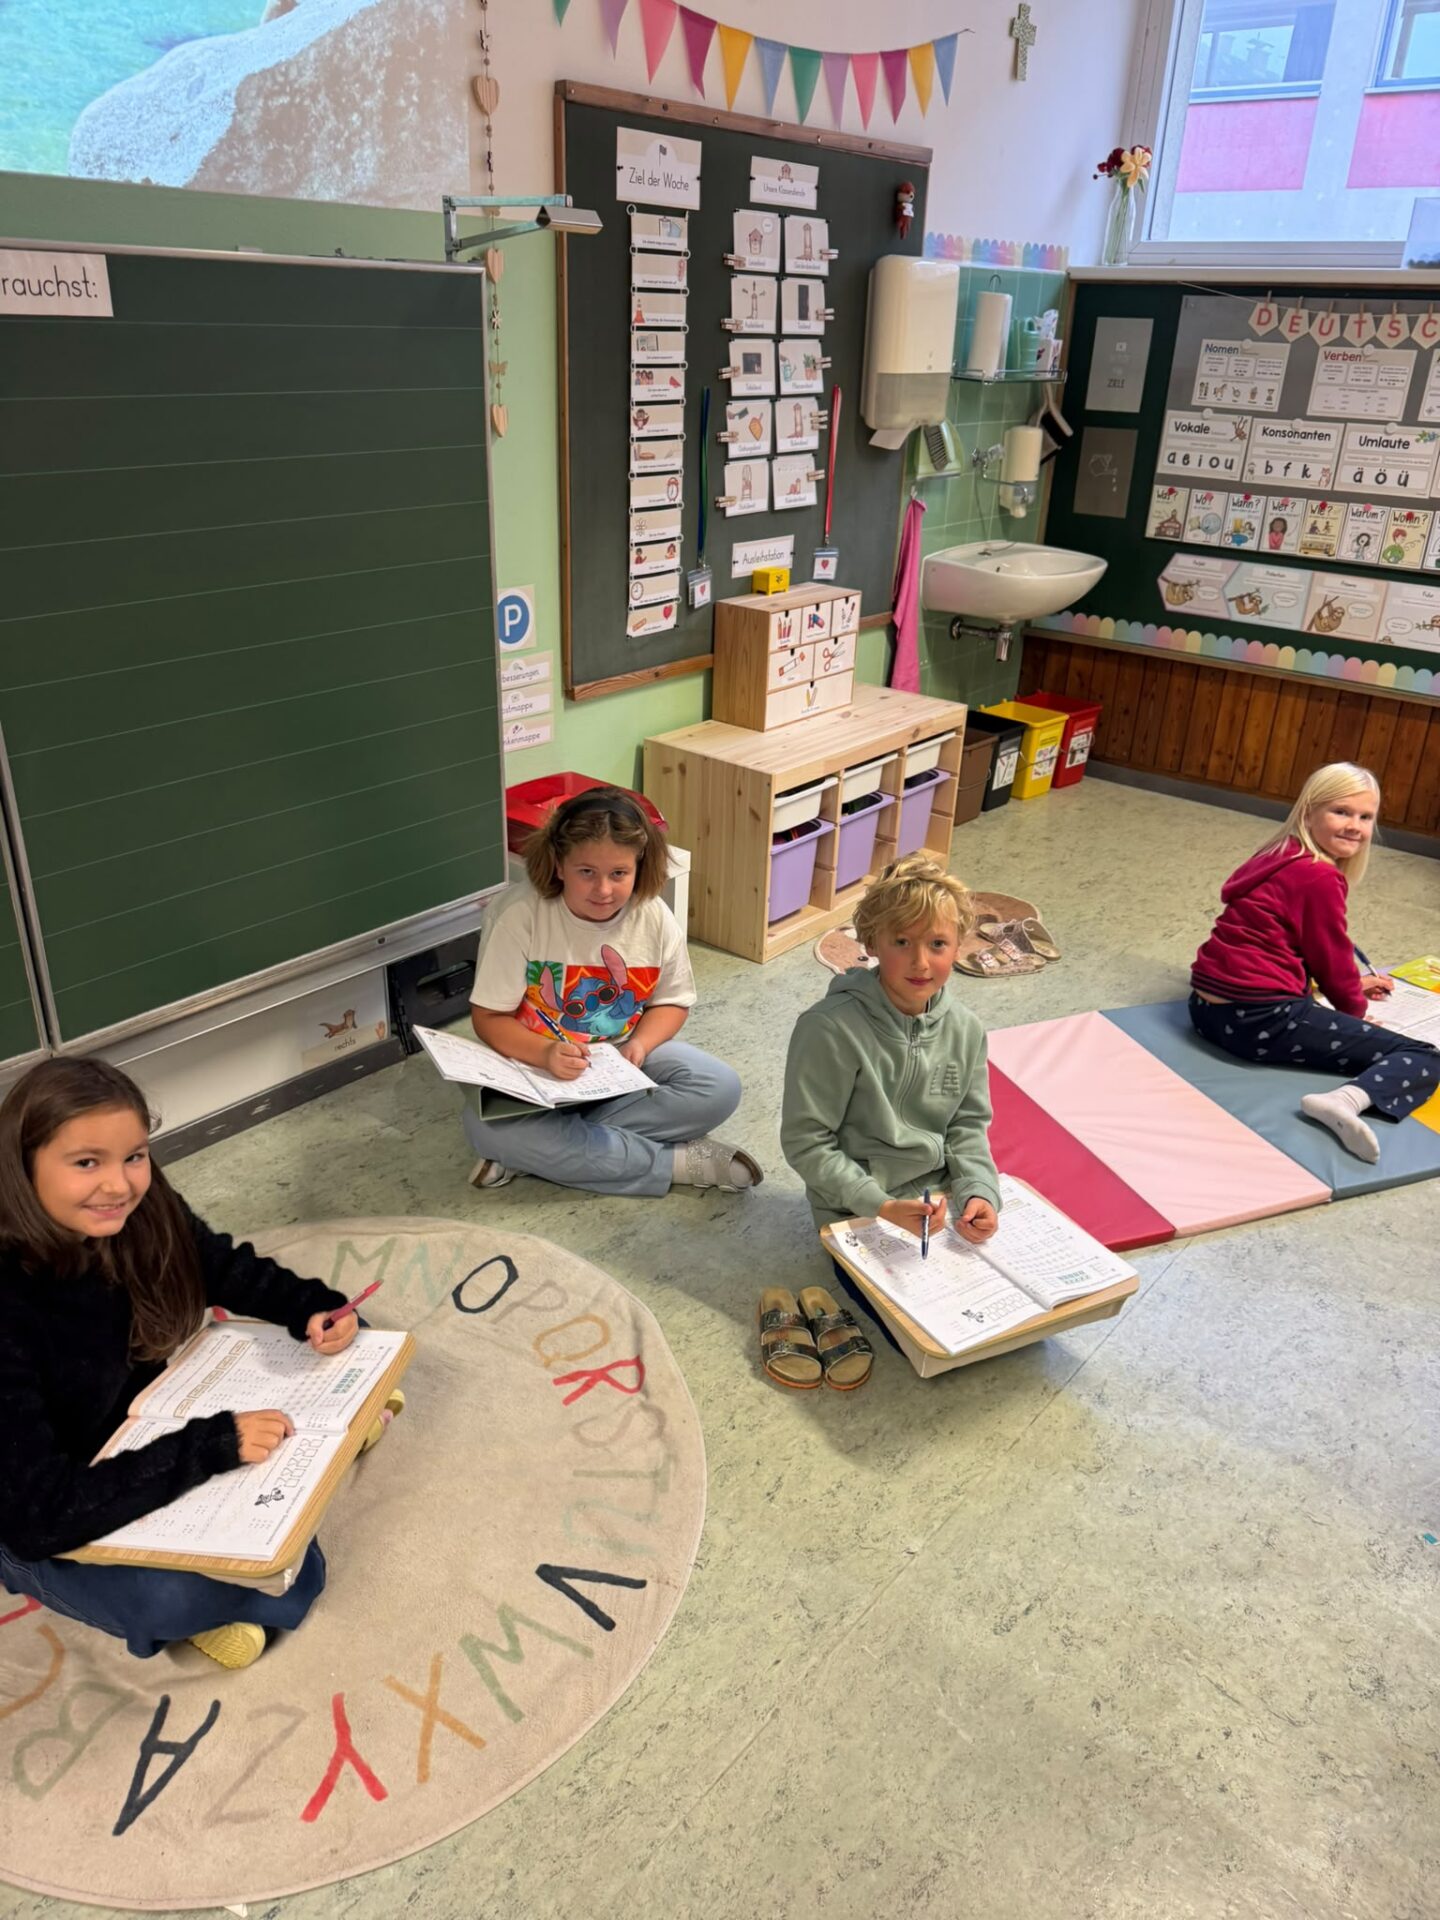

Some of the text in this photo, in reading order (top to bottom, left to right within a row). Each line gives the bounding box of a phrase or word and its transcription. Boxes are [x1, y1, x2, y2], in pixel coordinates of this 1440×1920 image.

[629, 166, 689, 191] Ziel der Woche
[1, 265, 98, 298] rauchst:
[1205, 343, 1239, 355] Nomen
[1323, 350, 1362, 362] Verben
[1174, 421, 1210, 434] Vokale
[1262, 426, 1331, 442] Konsonanten
[1359, 435, 1410, 450] Umlaute
[742, 548, 784, 565] Ausleihstation
[504, 604, 523, 637] P
[334, 1036, 356, 1052] rechts
[451, 1254, 520, 1314] O
[490, 1278, 569, 1326] P
[532, 1313, 611, 1368] Q
[552, 1355, 646, 1407] R
[534, 1562, 648, 1632] V
[385, 1651, 487, 1784] X
[111, 1693, 222, 1837] A
[299, 1692, 389, 1823] Y
